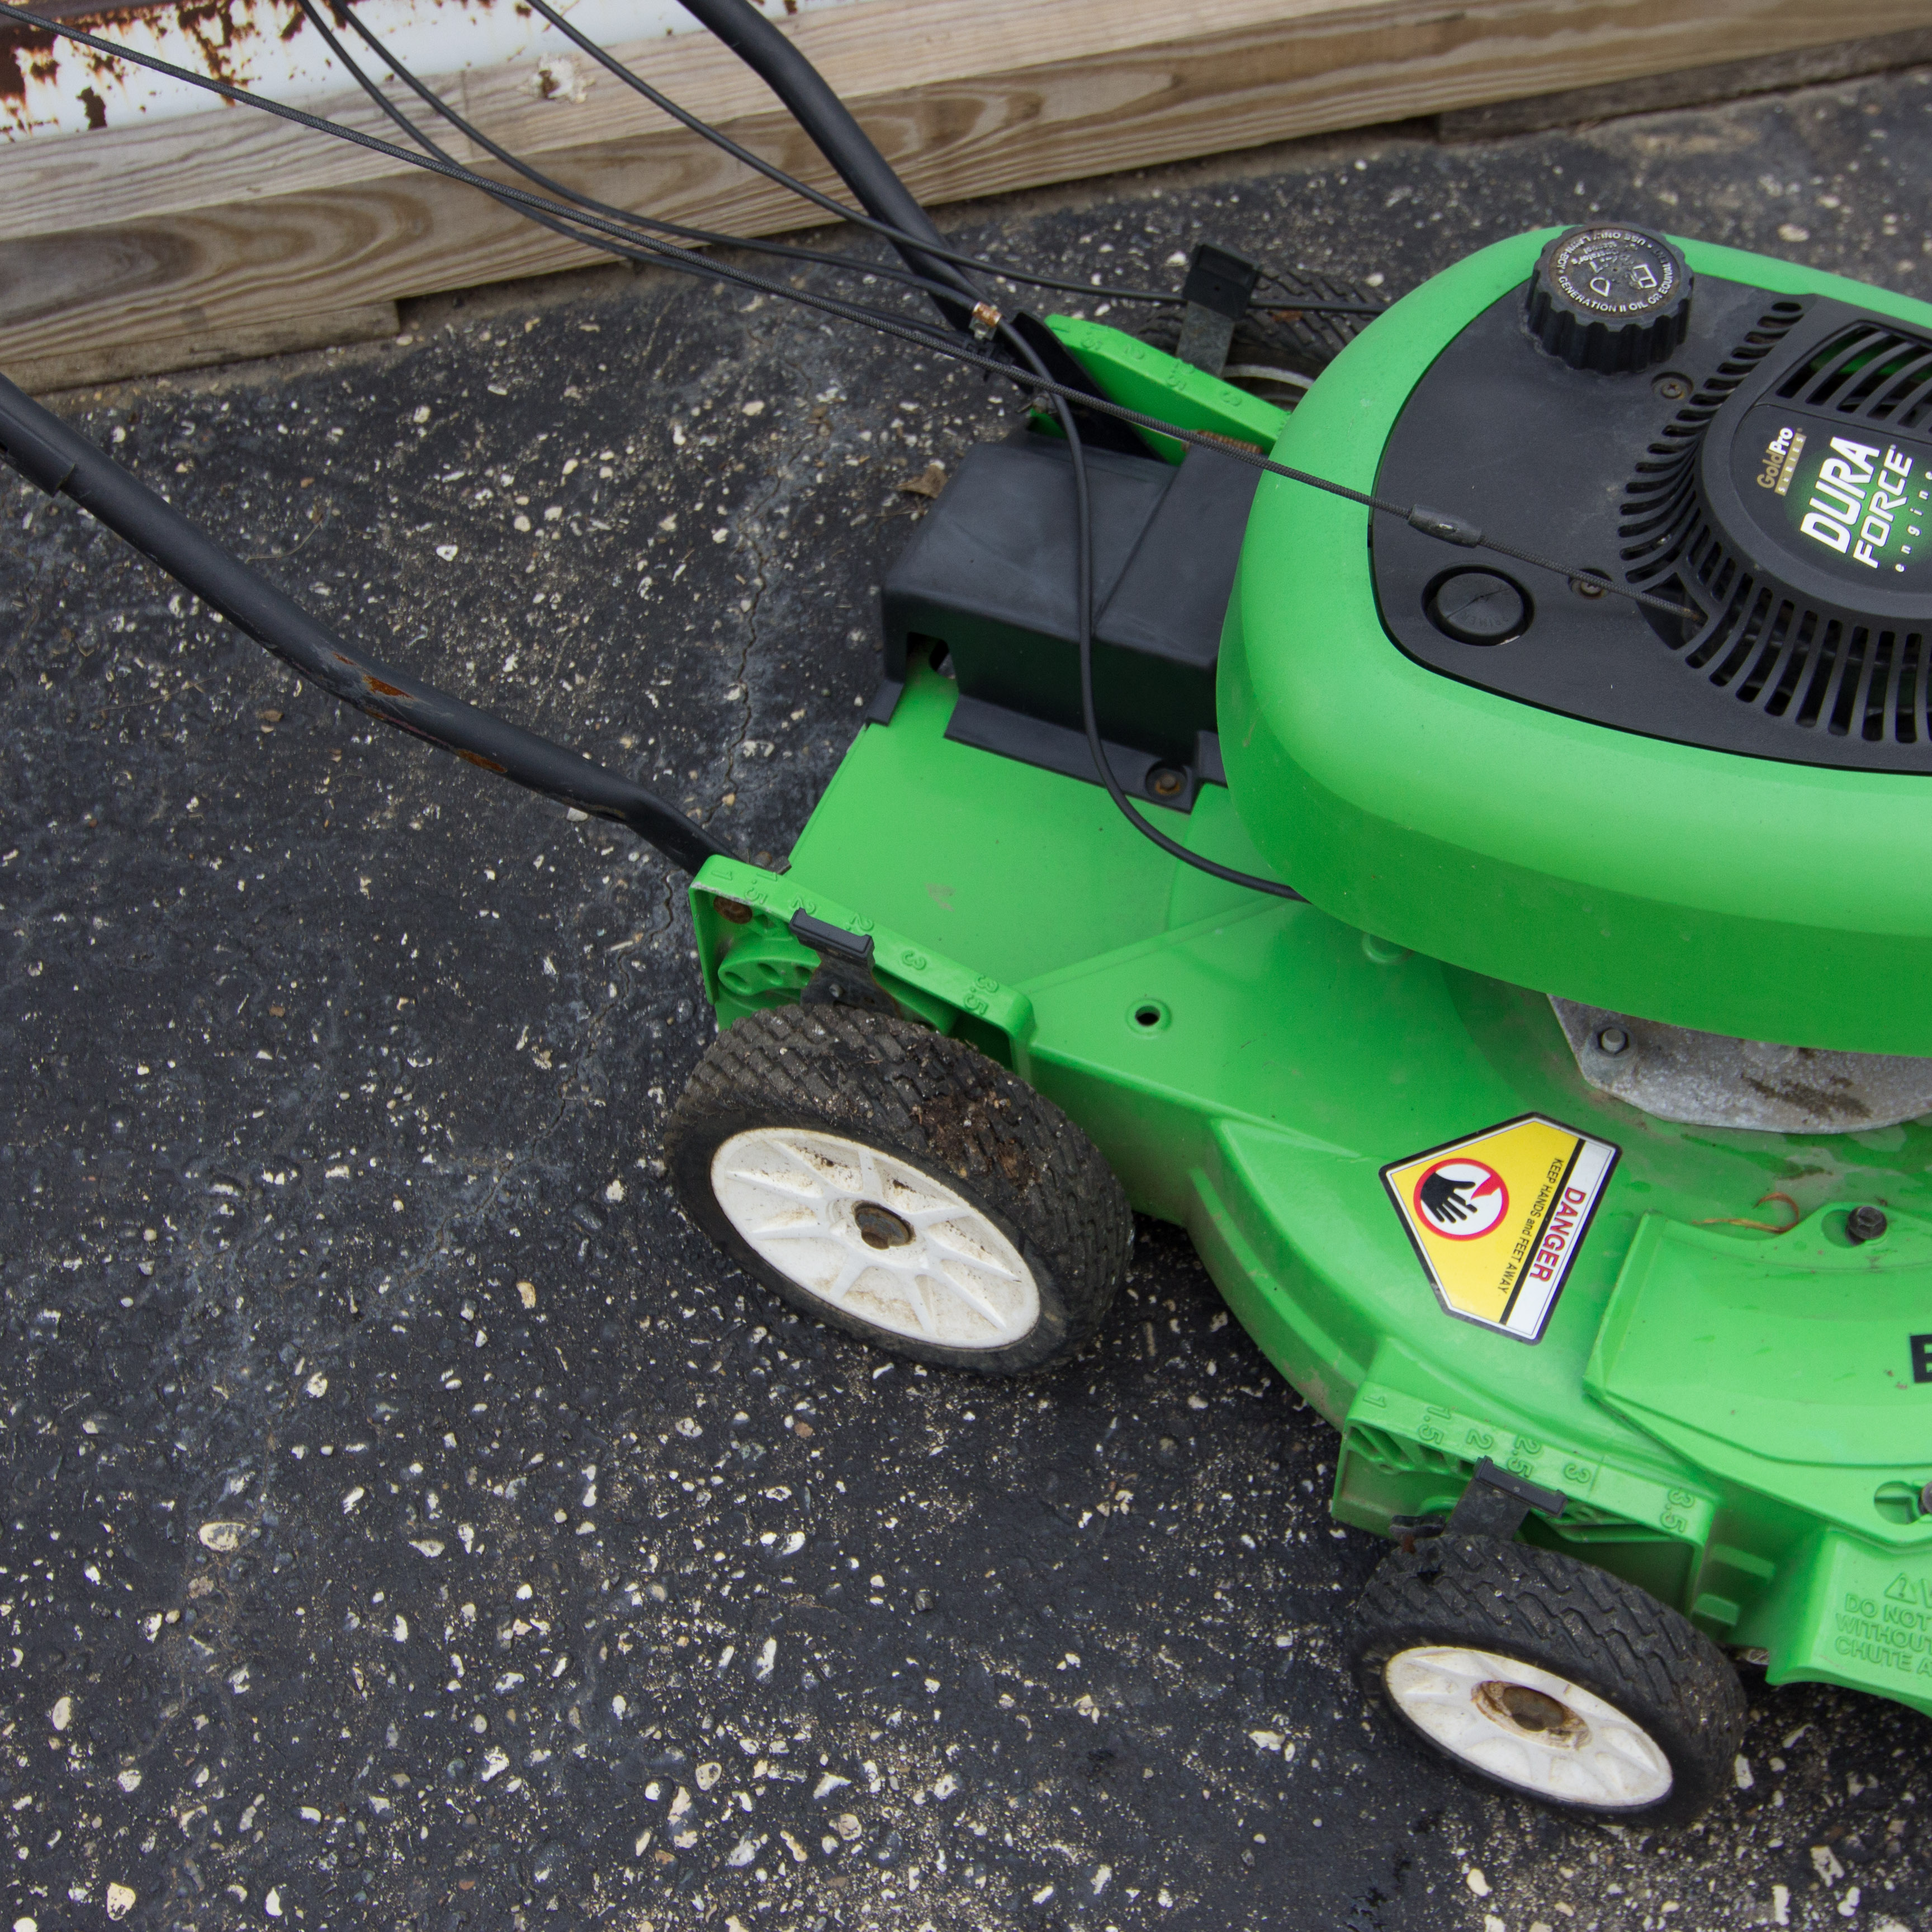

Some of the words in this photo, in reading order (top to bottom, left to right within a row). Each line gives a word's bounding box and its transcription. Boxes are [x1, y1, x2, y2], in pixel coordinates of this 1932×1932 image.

[1623, 232, 1646, 246] USE
[1558, 276, 1617, 312] GENERATION
[1628, 300, 1649, 311] OIL
[1647, 292, 1663, 304] OR
[1756, 427, 1794, 489] GoldPro
[1778, 437, 1805, 493] SERIES
[1800, 436, 1881, 554] DURA
[1853, 447, 1914, 569] FORCE
[902, 950, 927, 971] 3
[963, 974, 999, 1016] 3.5
[1546, 1158, 1564, 1185] KEEP
[1530, 1184, 1552, 1218] HANDS
[1522, 1219, 1535, 1237] and
[1530, 1186, 1587, 1282] DANGER
[1512, 1237, 1530, 1263] FEET
[1498, 1263, 1517, 1294] AWAY
[1418, 1405, 1452, 1447] 1.5
[1466, 1428, 1494, 1450] 2
[1507, 1434, 1542, 1479] 2.5
[1564, 1462, 1592, 1484] 3
[1660, 1488, 1696, 1533] 3.5
[1845, 1593, 1877, 1618] DO
[1883, 1604, 1932, 1632] NOT
[1835, 1636, 1912, 1672] CHUTE
